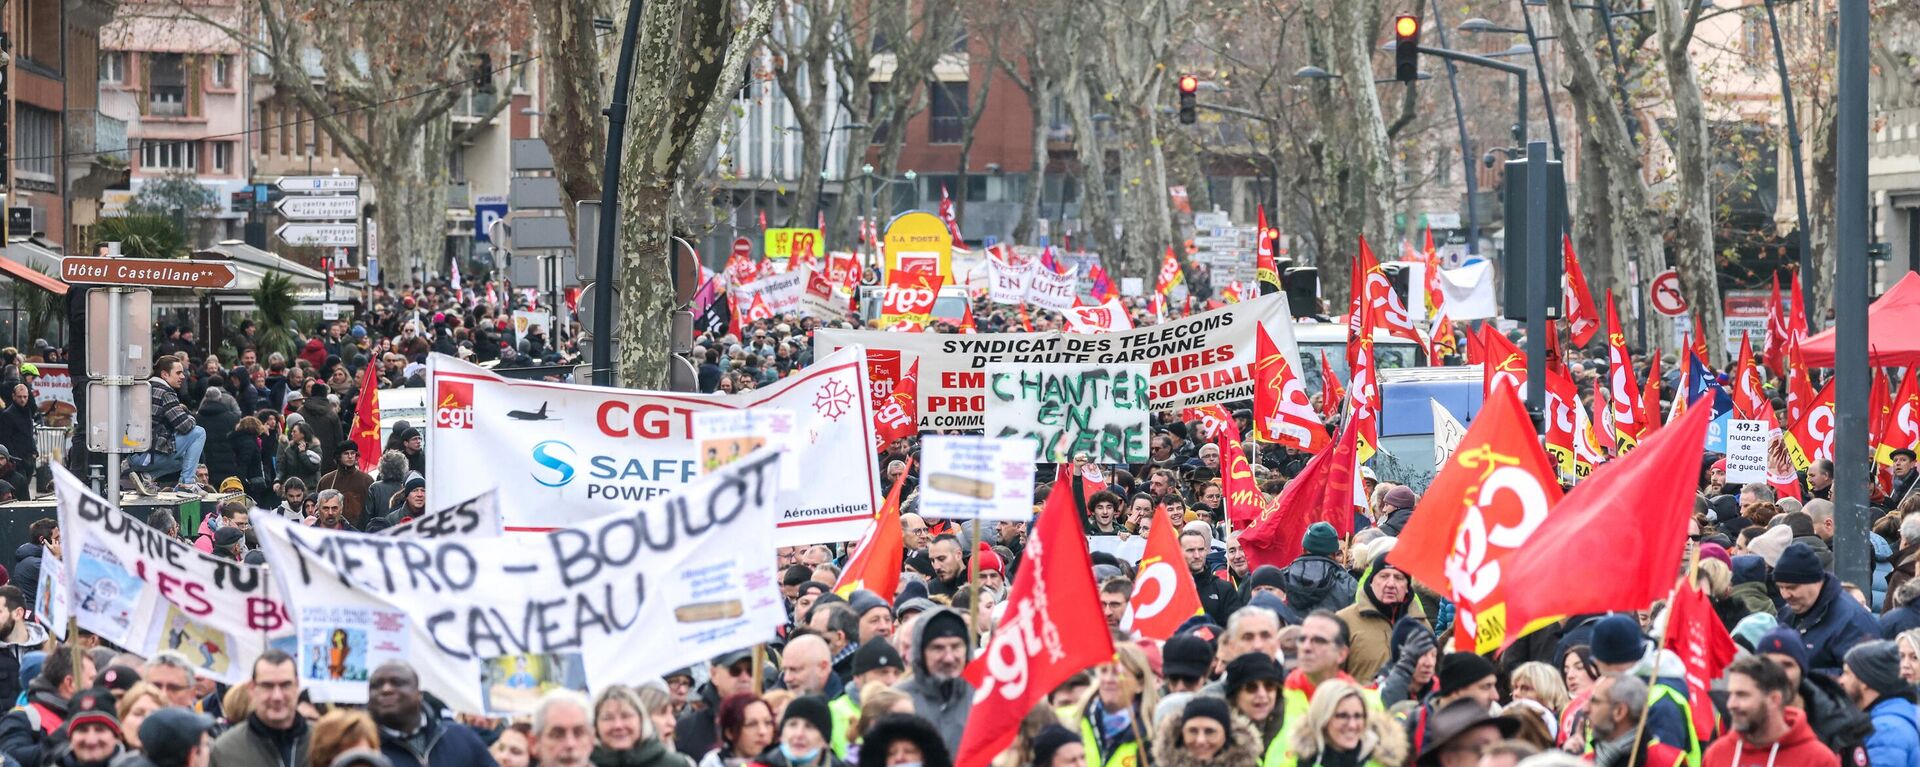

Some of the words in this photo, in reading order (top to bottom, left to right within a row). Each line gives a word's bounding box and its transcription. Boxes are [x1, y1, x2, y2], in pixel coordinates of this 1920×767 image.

[67, 263, 109, 278] Hôtel
[999, 275, 1021, 289] EN
[1031, 277, 1072, 297] LUTTE
[942, 338, 1060, 354] SYNDICAT
[1067, 339, 1111, 353] DES
[1120, 312, 1234, 349] TELECOMS
[972, 356, 1001, 369] DE
[1098, 334, 1206, 363] GARONNE
[875, 364, 890, 375] Fapt
[991, 369, 1150, 410] CHANTIER
[437, 404, 473, 429] cgt
[596, 400, 694, 440] CGT
[1037, 400, 1092, 432] EN
[1736, 423, 1760, 432] 49.3
[1729, 434, 1766, 442] nuances
[1739, 463, 1766, 472] gueule
[391, 497, 479, 538] SES
[548, 452, 781, 588] BOULOT
[784, 502, 868, 519] Aéronautique
[78, 493, 189, 572] BORNE
[199, 553, 259, 592] TU
[426, 573, 645, 660] CAVEAU
